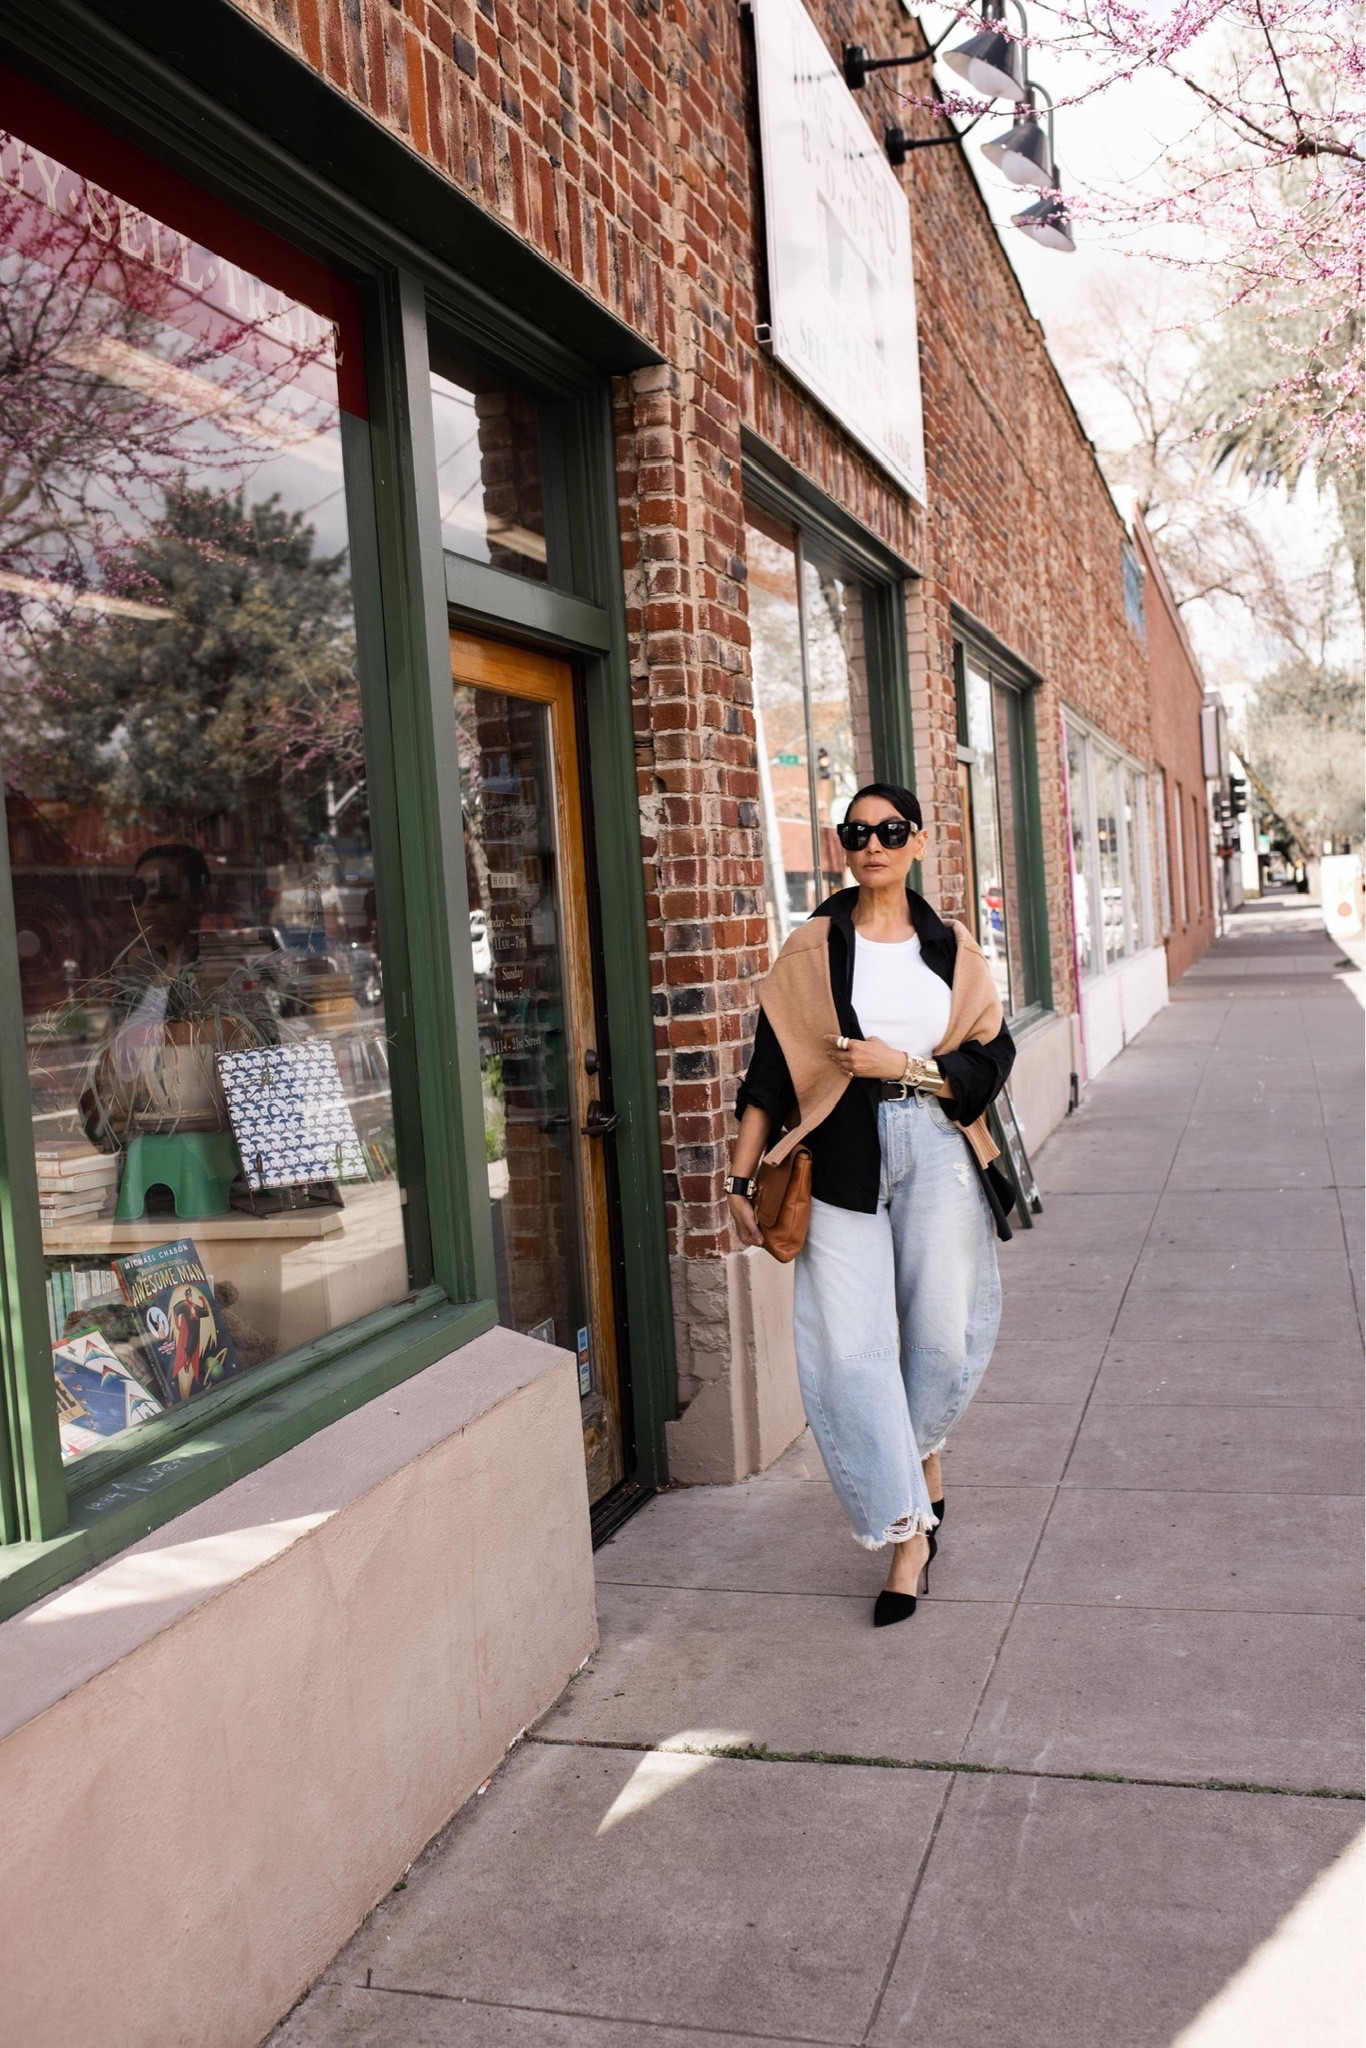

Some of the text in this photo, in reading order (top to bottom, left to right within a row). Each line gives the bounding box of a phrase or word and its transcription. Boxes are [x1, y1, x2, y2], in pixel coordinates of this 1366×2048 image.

[838, 112, 897, 257] TESTED
[85, 178, 204, 291] SELL
[800, 318, 830, 380] SELL
[484, 914, 505, 931] onday
[502, 965, 523, 982] Sunday
[524, 1034, 542, 1048] Street
[124, 1254, 156, 1270] MICHAEL
[158, 1244, 188, 1259] CHABON
[131, 1267, 178, 1306] AWESOME
[177, 1263, 205, 1281] MAN
